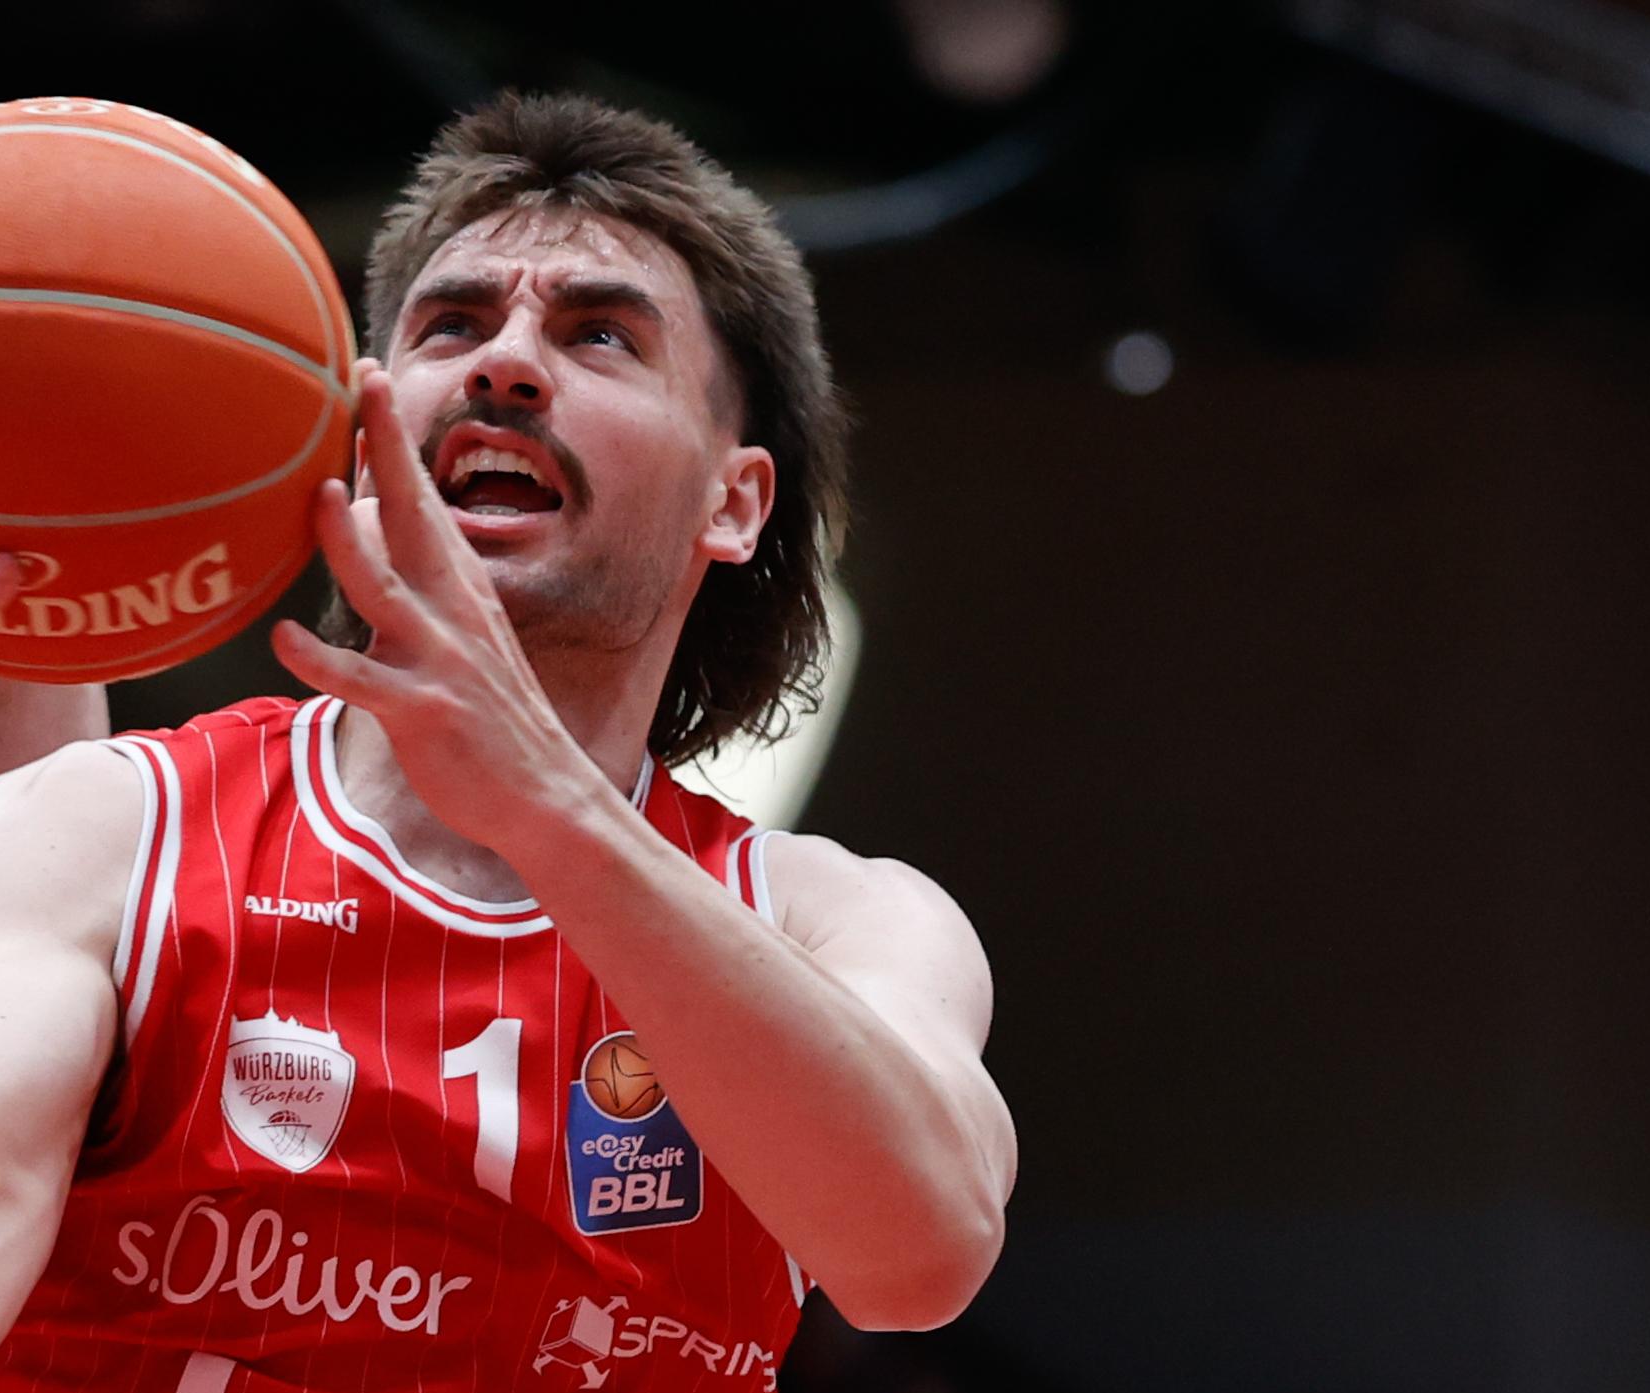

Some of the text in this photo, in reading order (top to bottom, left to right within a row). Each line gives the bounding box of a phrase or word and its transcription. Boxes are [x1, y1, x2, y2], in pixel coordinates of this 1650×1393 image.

[244, 895, 359, 934] ALDING
[445, 1018, 522, 1203] 1
[613, 1147, 685, 1173] Credit
[587, 1170, 686, 1217] BBL
[112, 1195, 472, 1335] s.Oliver
